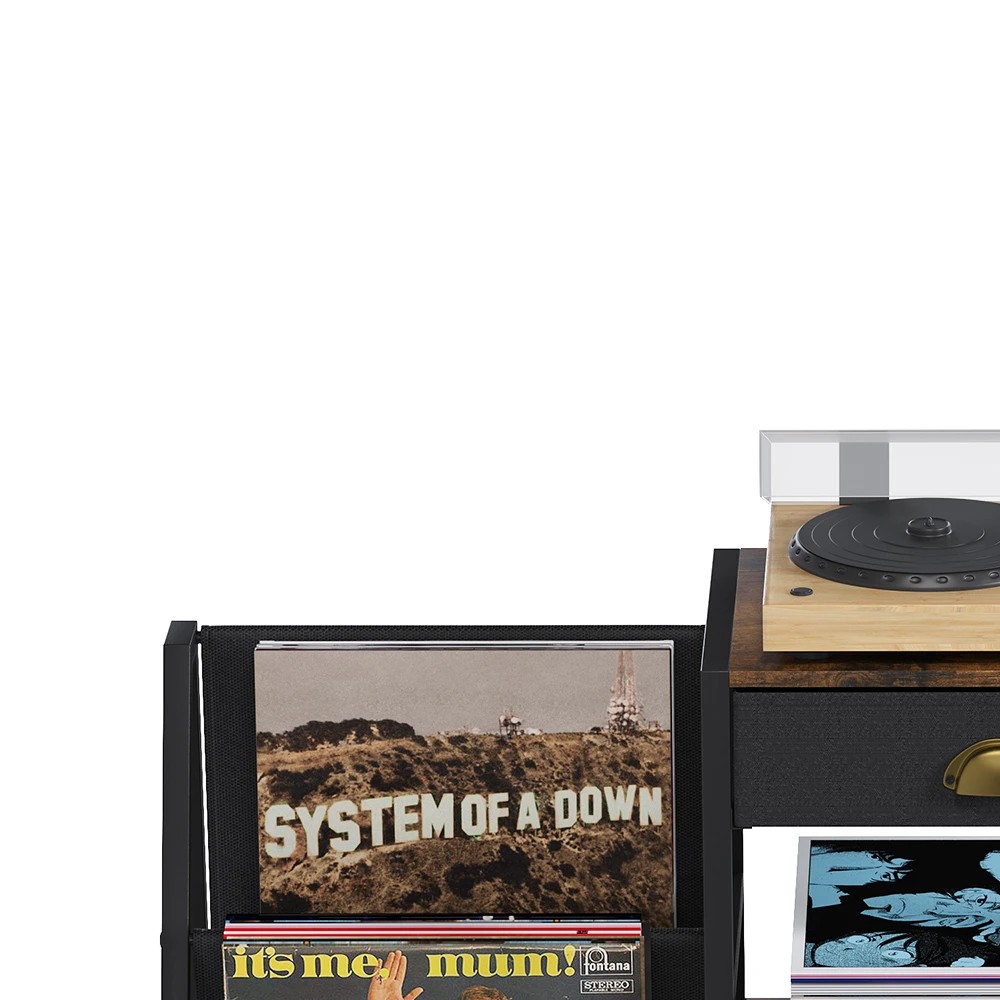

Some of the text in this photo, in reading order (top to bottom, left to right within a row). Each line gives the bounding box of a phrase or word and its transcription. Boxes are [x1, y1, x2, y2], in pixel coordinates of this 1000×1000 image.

[265, 785, 663, 858] SYSTEM OF A DOWN
[232, 944, 576, 981] it's me, mum!
[584, 947, 631, 975] fontana
[584, 980, 630, 989] STEREO
